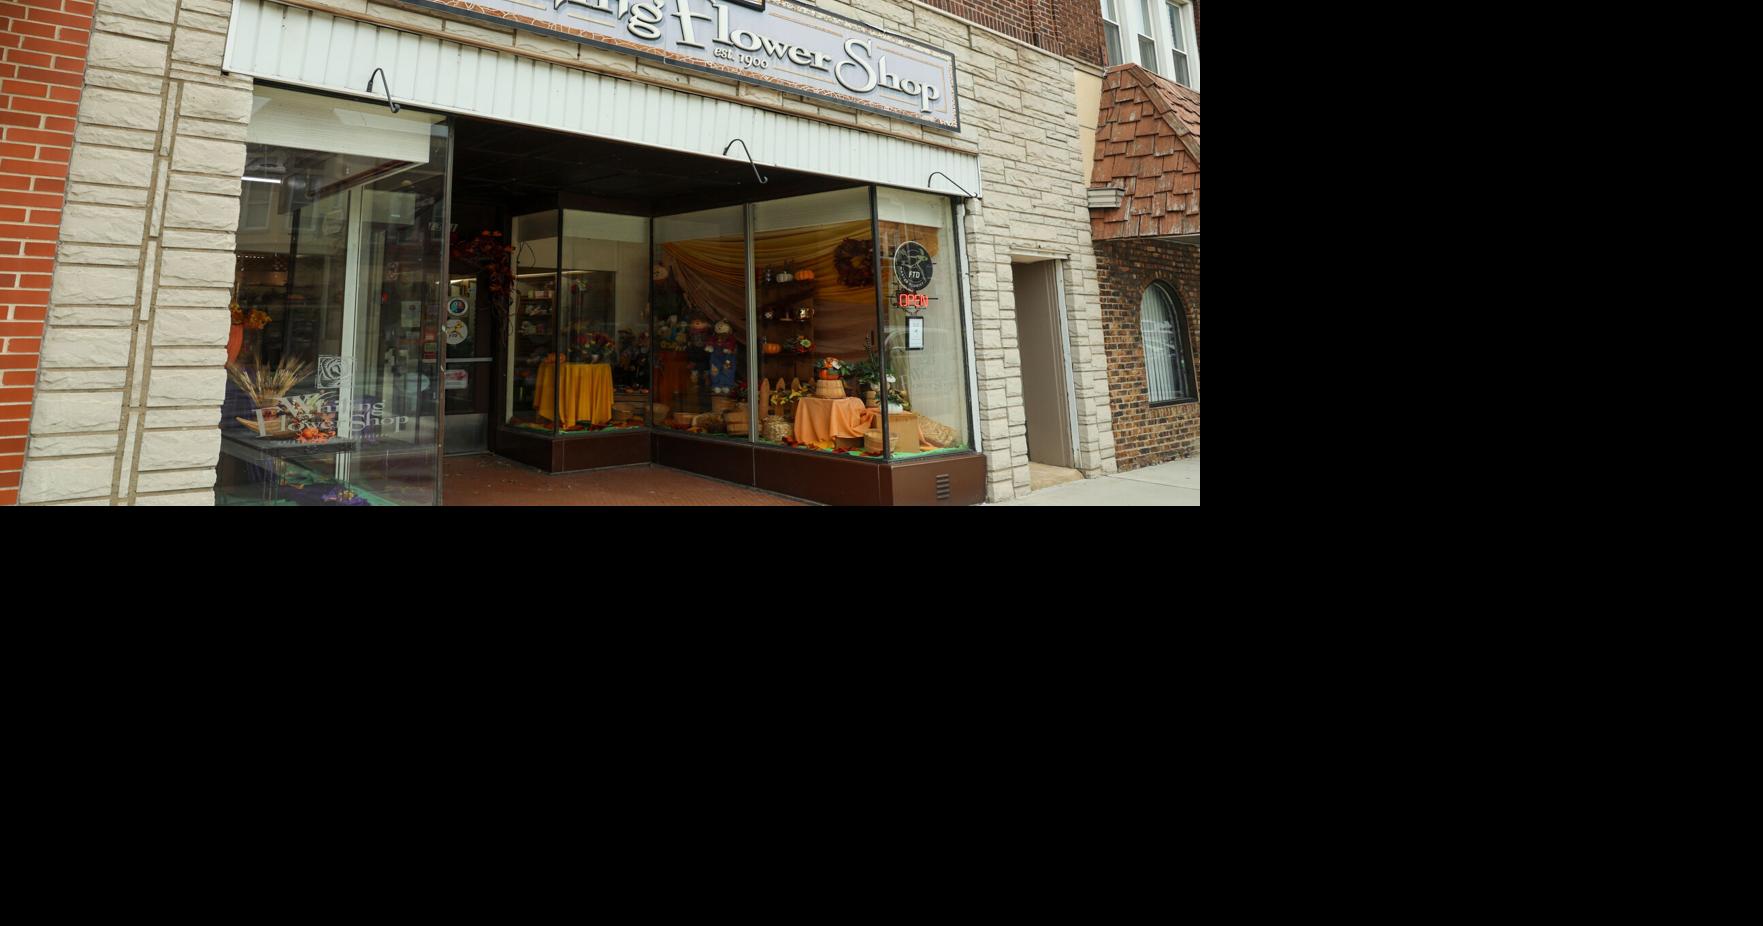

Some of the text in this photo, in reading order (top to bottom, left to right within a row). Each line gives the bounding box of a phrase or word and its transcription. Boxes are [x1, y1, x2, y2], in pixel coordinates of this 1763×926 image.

[713, 46, 768, 70] est. 1900
[834, 37, 940, 113] Shop
[908, 270, 921, 279] FTD
[899, 293, 928, 308] OPEN
[350, 411, 409, 434] Shop
